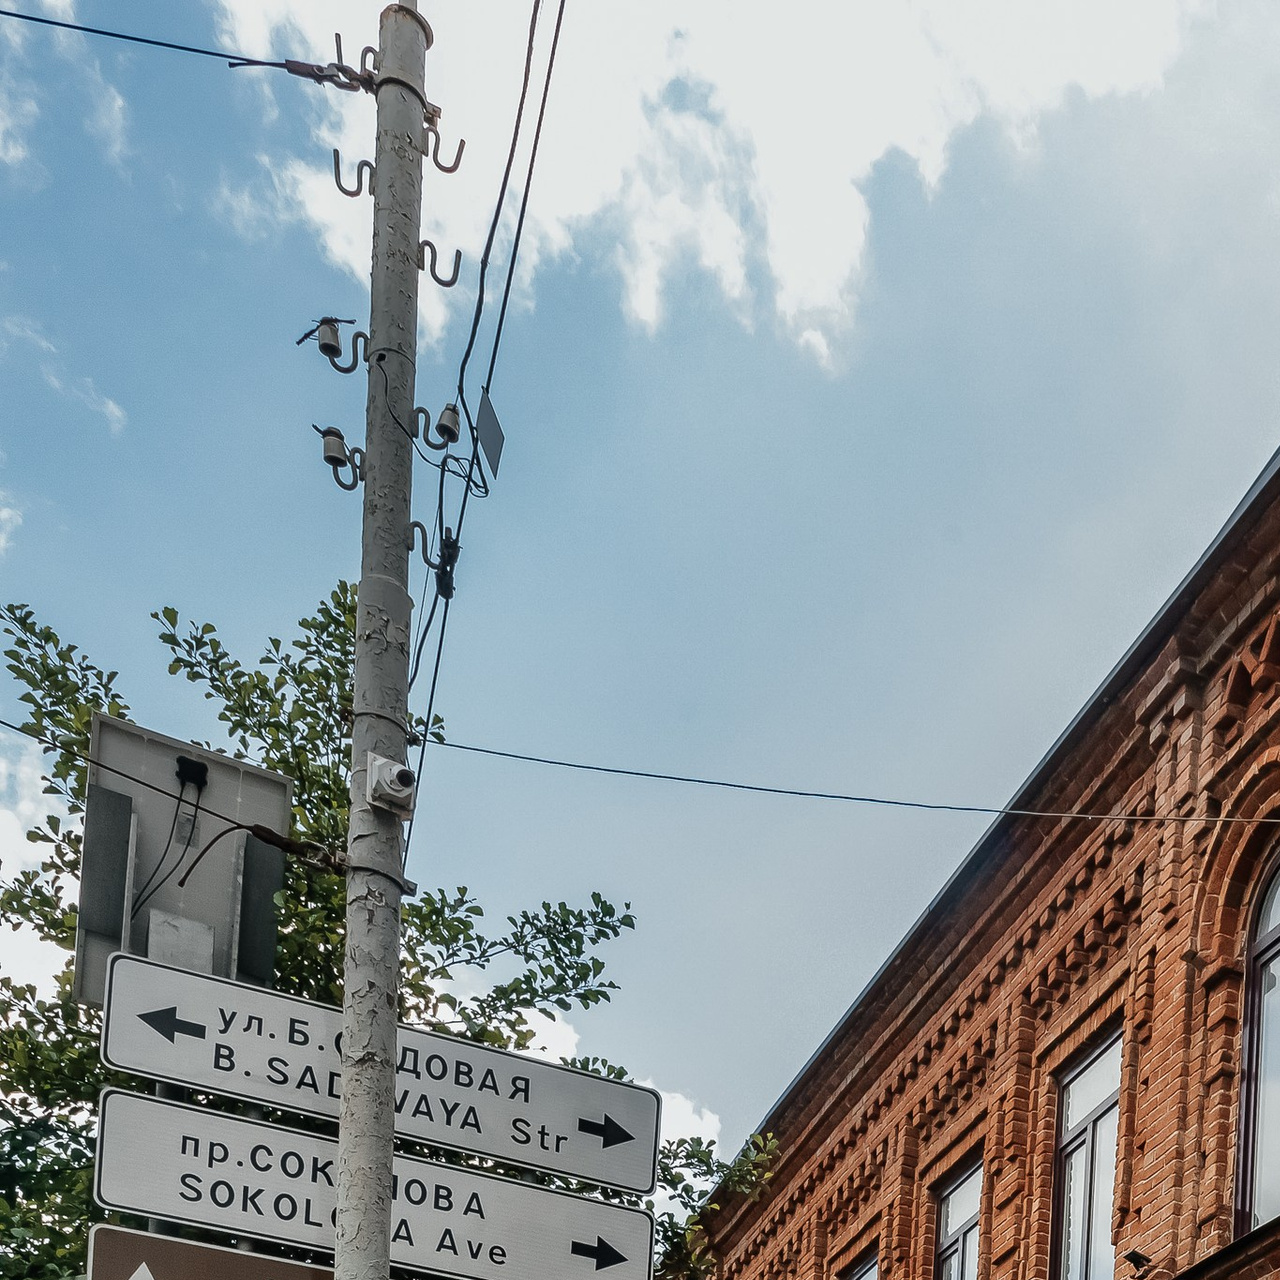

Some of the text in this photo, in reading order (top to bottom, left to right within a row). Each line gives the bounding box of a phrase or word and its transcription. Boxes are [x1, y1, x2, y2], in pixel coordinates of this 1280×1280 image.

[217, 1006, 531, 1104] ул.Б.ДОВАЯ
[180, 1134, 486, 1220] пр.СОКОВА
[510, 1117, 569, 1153] Str
[178, 1173, 508, 1265] SOKOLA Ave
